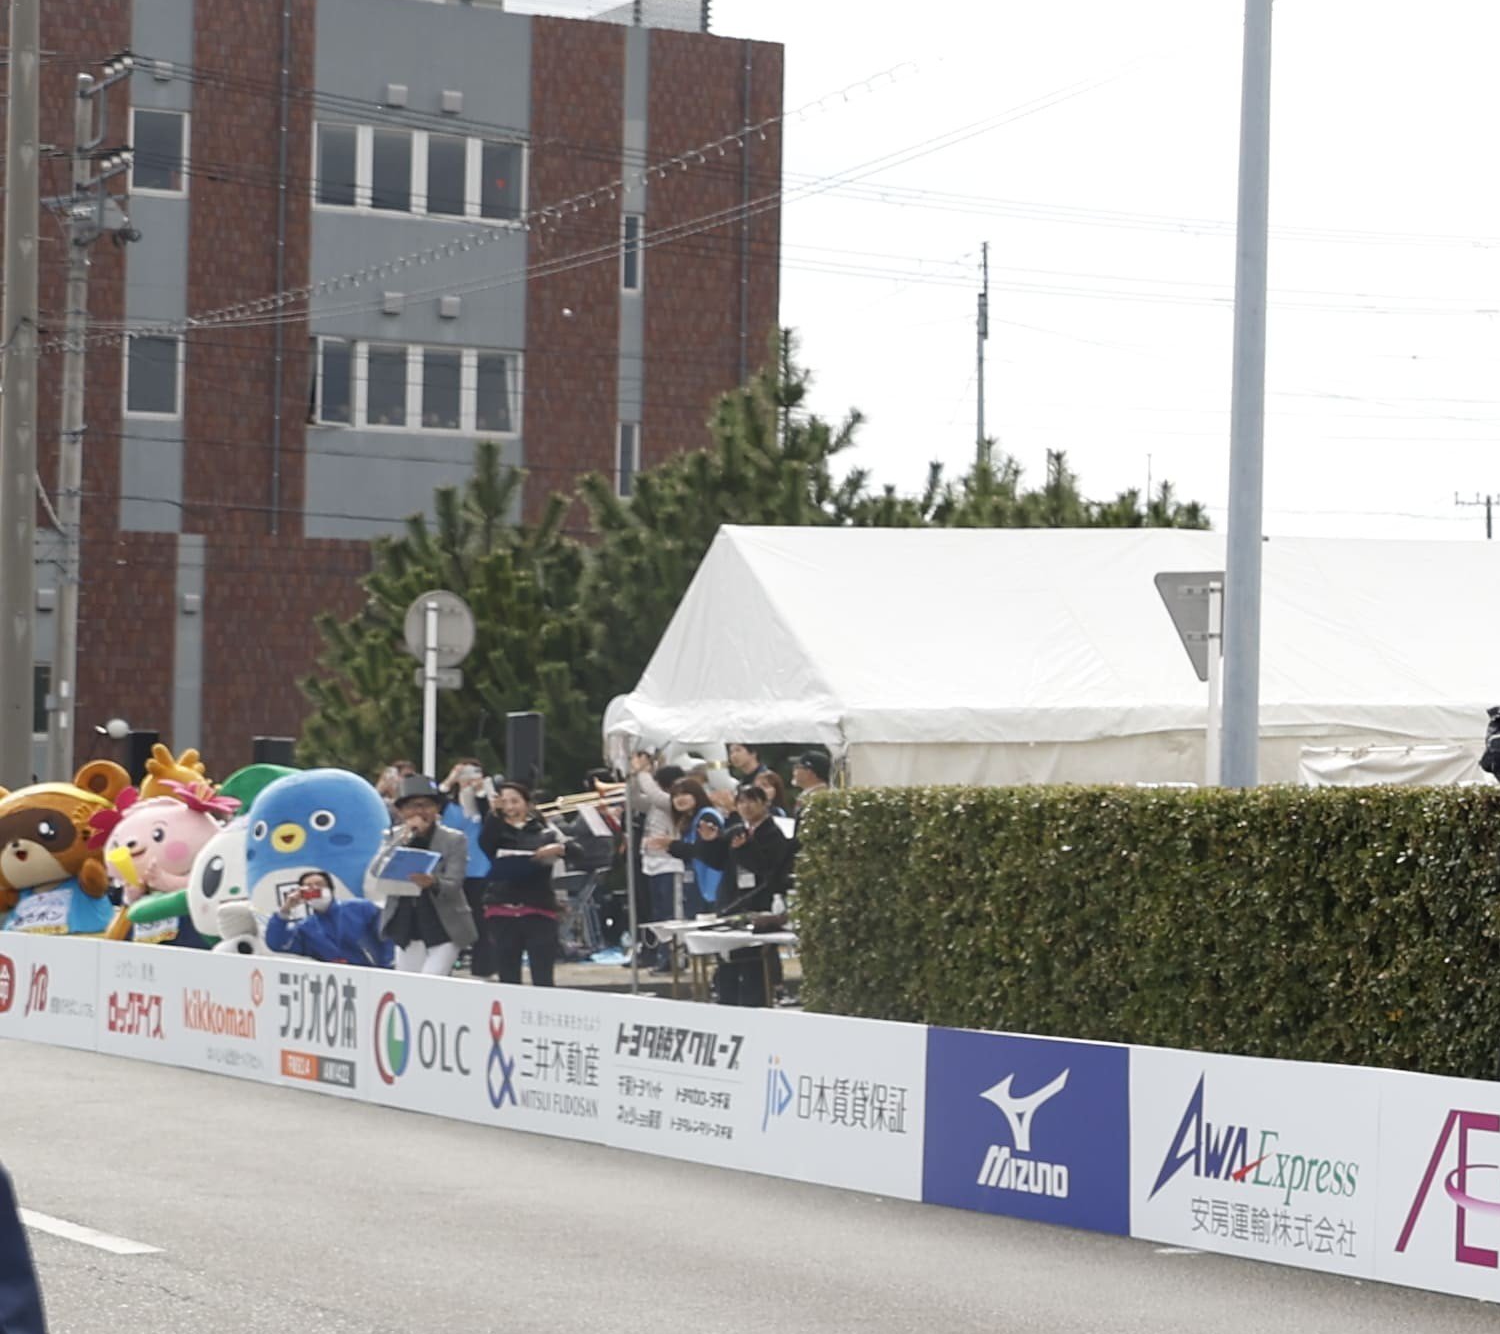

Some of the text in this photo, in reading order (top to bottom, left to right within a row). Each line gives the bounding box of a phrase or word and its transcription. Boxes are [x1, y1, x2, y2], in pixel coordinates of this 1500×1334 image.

[183, 988, 257, 1040] kikkoman
[419, 1020, 471, 1076] OLC
[521, 1038, 599, 1087] 三井不動産
[797, 1075, 908, 1134] 日本賃貸保証
[1253, 1128, 1359, 1205] Express
[1190, 1198, 1357, 1258] 安房運輸株式会社
